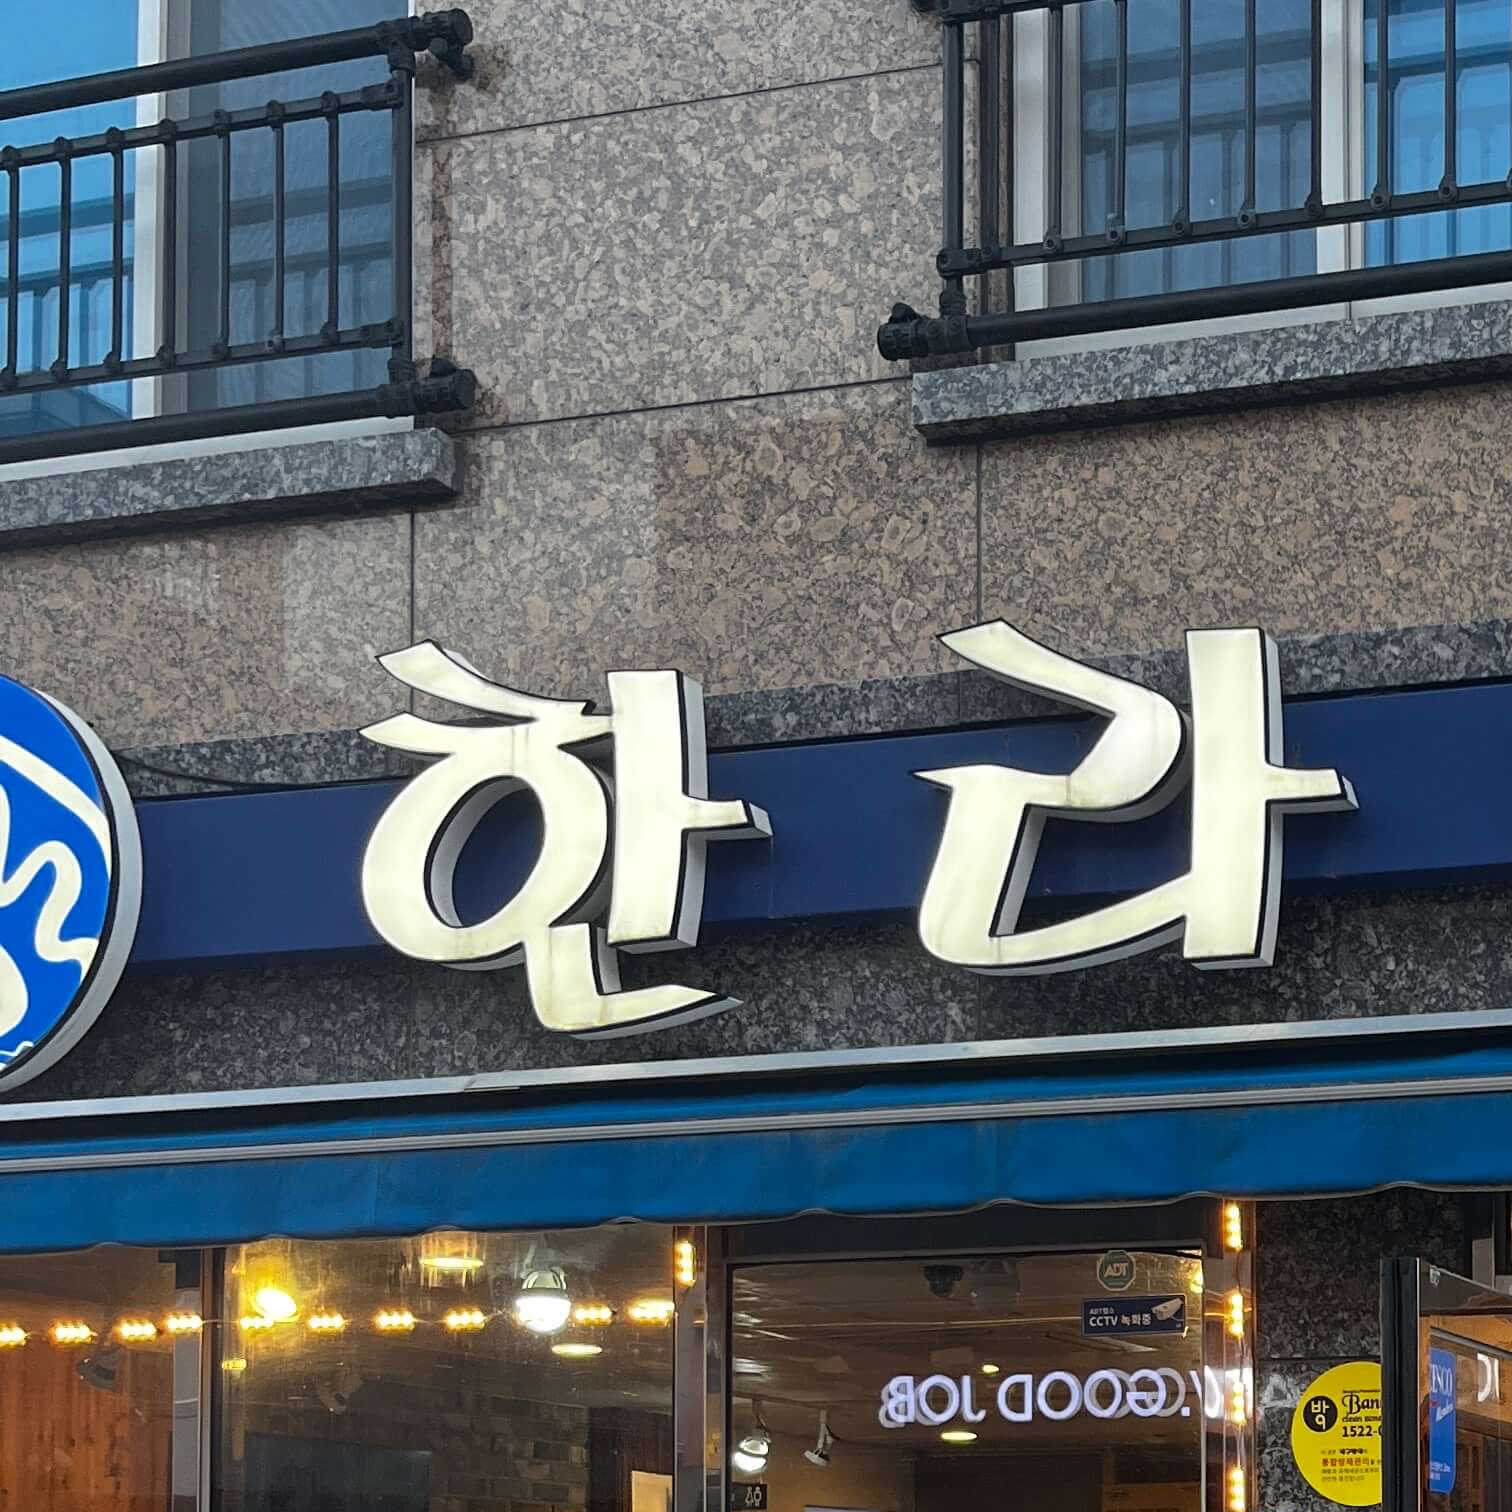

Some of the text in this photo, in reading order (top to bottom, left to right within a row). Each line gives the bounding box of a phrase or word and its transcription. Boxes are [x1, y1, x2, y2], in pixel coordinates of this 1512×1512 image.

[1104, 1262, 1128, 1277] ADT
[1089, 1315, 1118, 1327] CCTV
[1429, 1363, 1453, 1394] ESCO
[1342, 1394, 1382, 1415] Ban
